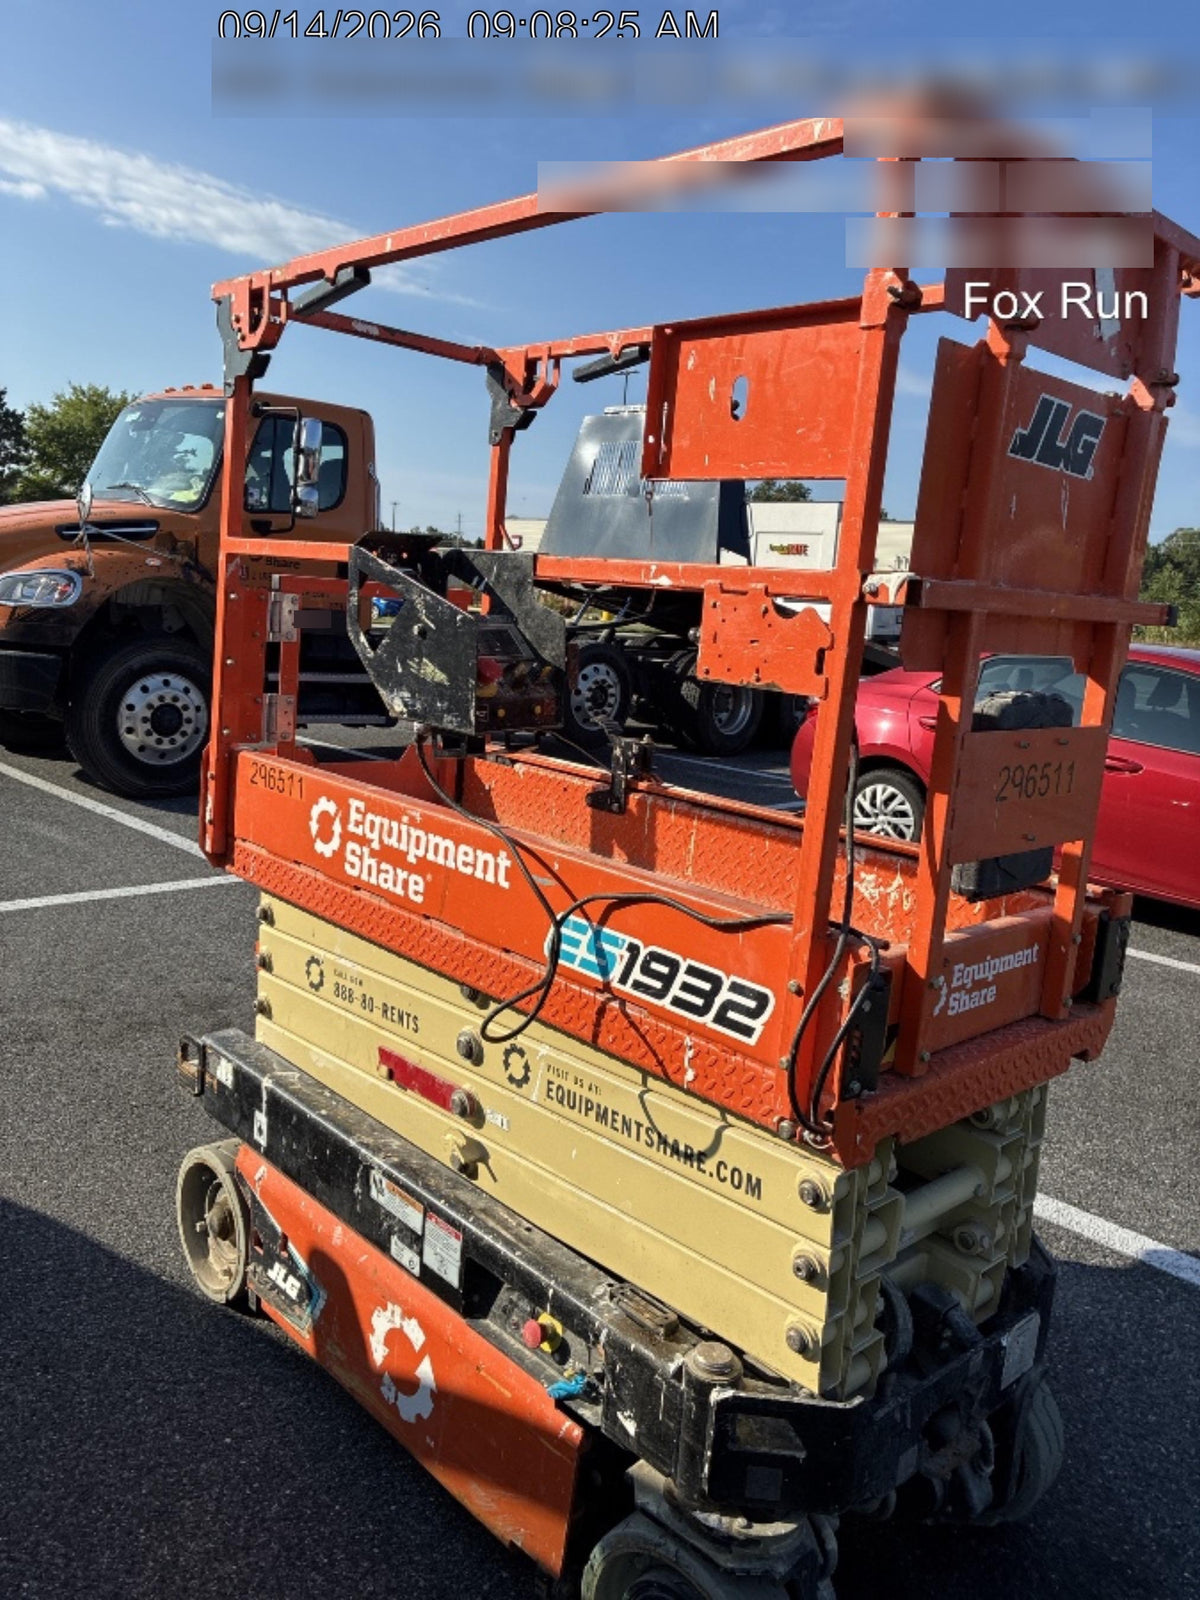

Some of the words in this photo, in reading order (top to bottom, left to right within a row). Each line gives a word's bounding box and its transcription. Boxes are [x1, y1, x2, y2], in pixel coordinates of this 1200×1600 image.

[1007, 393, 1107, 479] JLG
[249, 761, 304, 800] 296511
[995, 760, 1075, 802] 296511
[347, 797, 512, 890] Equipment
[544, 913, 774, 1044] ES1932
[951, 942, 1040, 989] Equipment
[333, 980, 420, 1034] 888-80-RENTS
[947, 984, 997, 1016] Share
[545, 1079, 763, 1201] EQUIPMENTSHARE.COM
[266, 1261, 302, 1300] JLG
